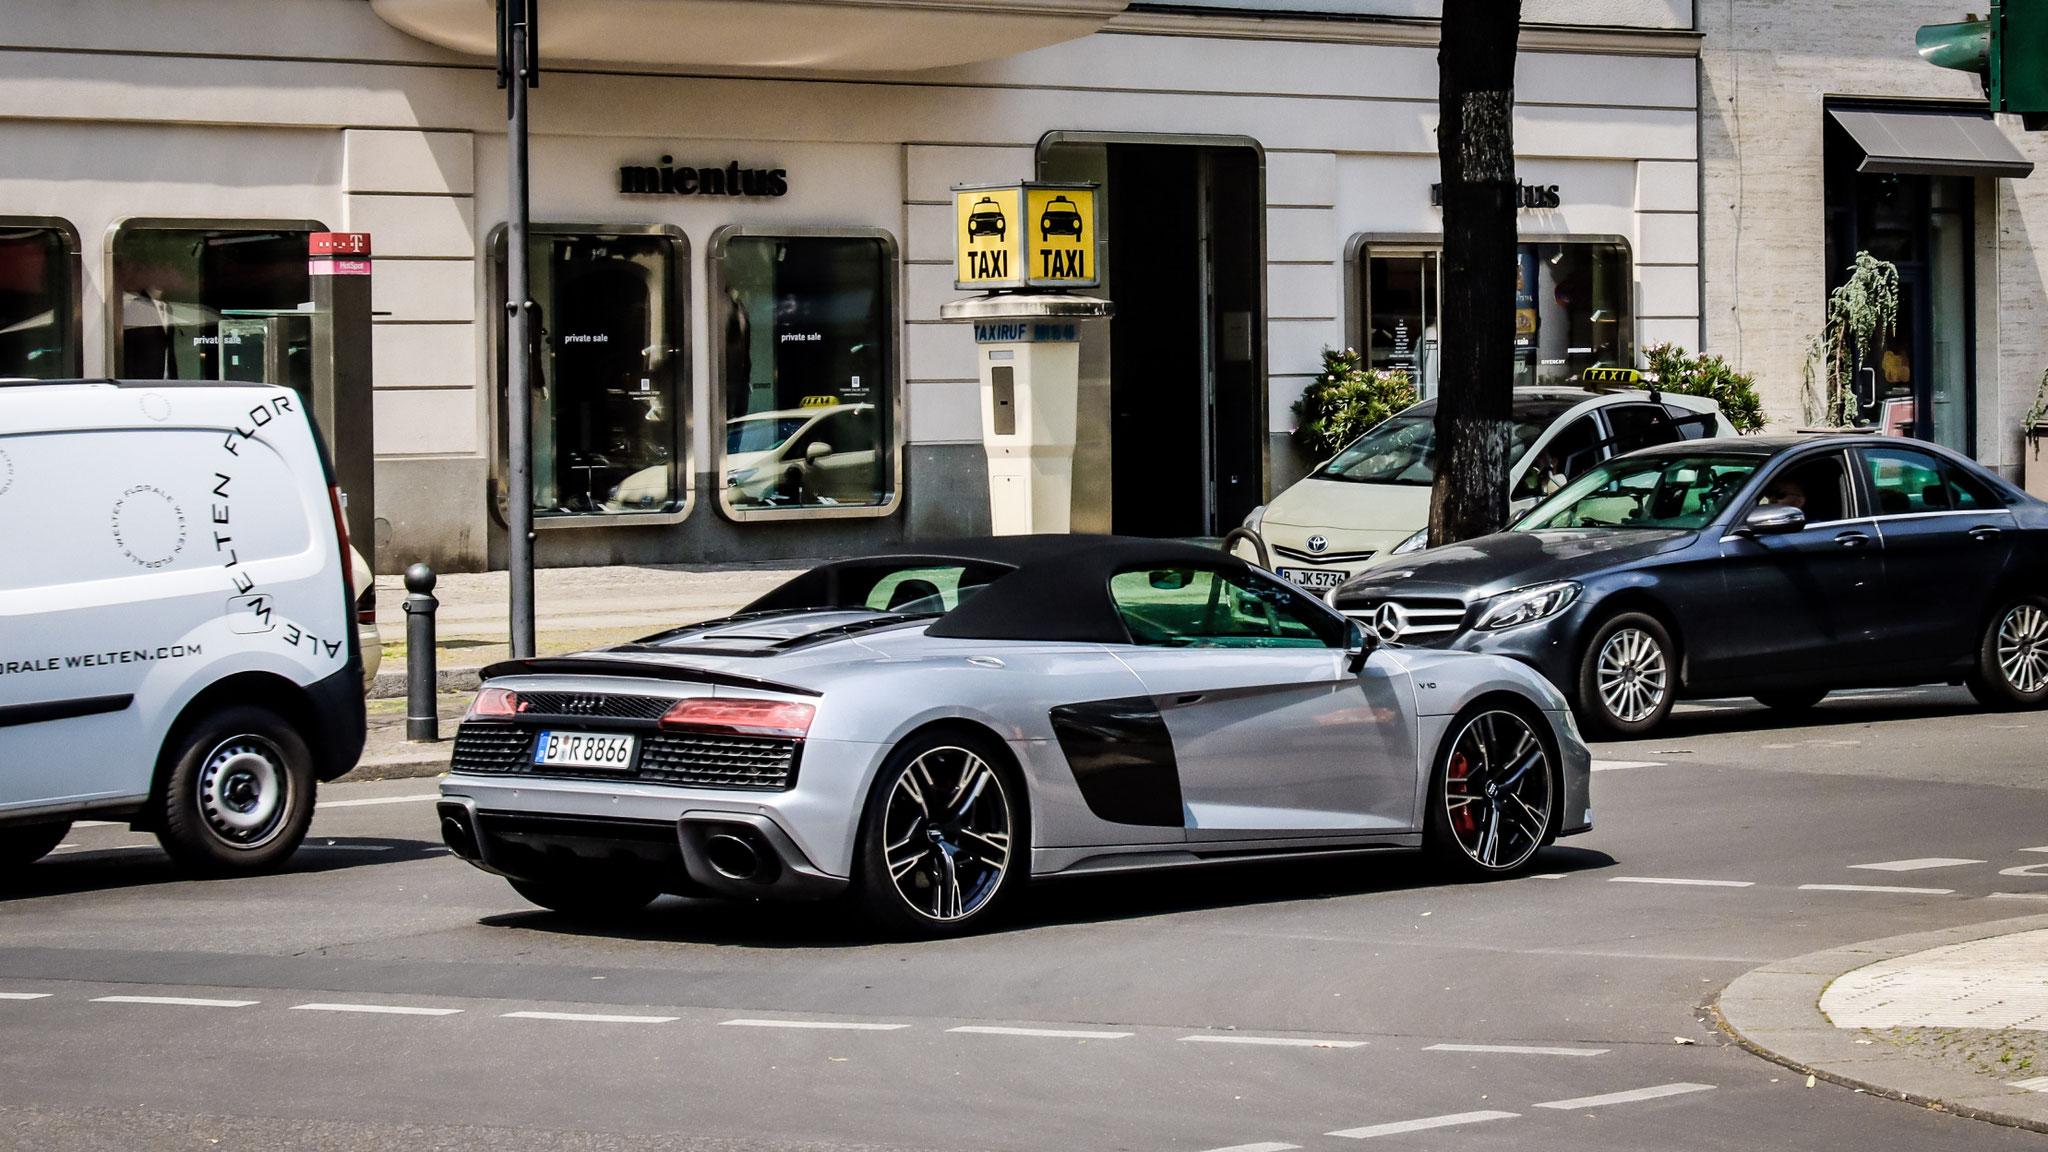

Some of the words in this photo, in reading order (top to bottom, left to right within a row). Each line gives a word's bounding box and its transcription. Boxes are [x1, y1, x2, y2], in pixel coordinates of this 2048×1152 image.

[619, 155, 788, 196] mientus
[339, 261, 364, 270] HotSpot
[968, 249, 1008, 279] TAXI
[1040, 249, 1084, 278] TAXI
[193, 335, 222, 347] privat
[564, 333, 591, 344] private
[592, 333, 609, 342] sale
[781, 332, 806, 343] private
[807, 332, 822, 341] sale
[974, 323, 1027, 341] TAXIRUF
[1591, 370, 1626, 381] TAXI
[212, 472, 272, 626] WELTEN
[1299, 572, 1314, 585] JK
[65, 643, 203, 668] WELTEN.COM
[583, 737, 628, 763] 8866
